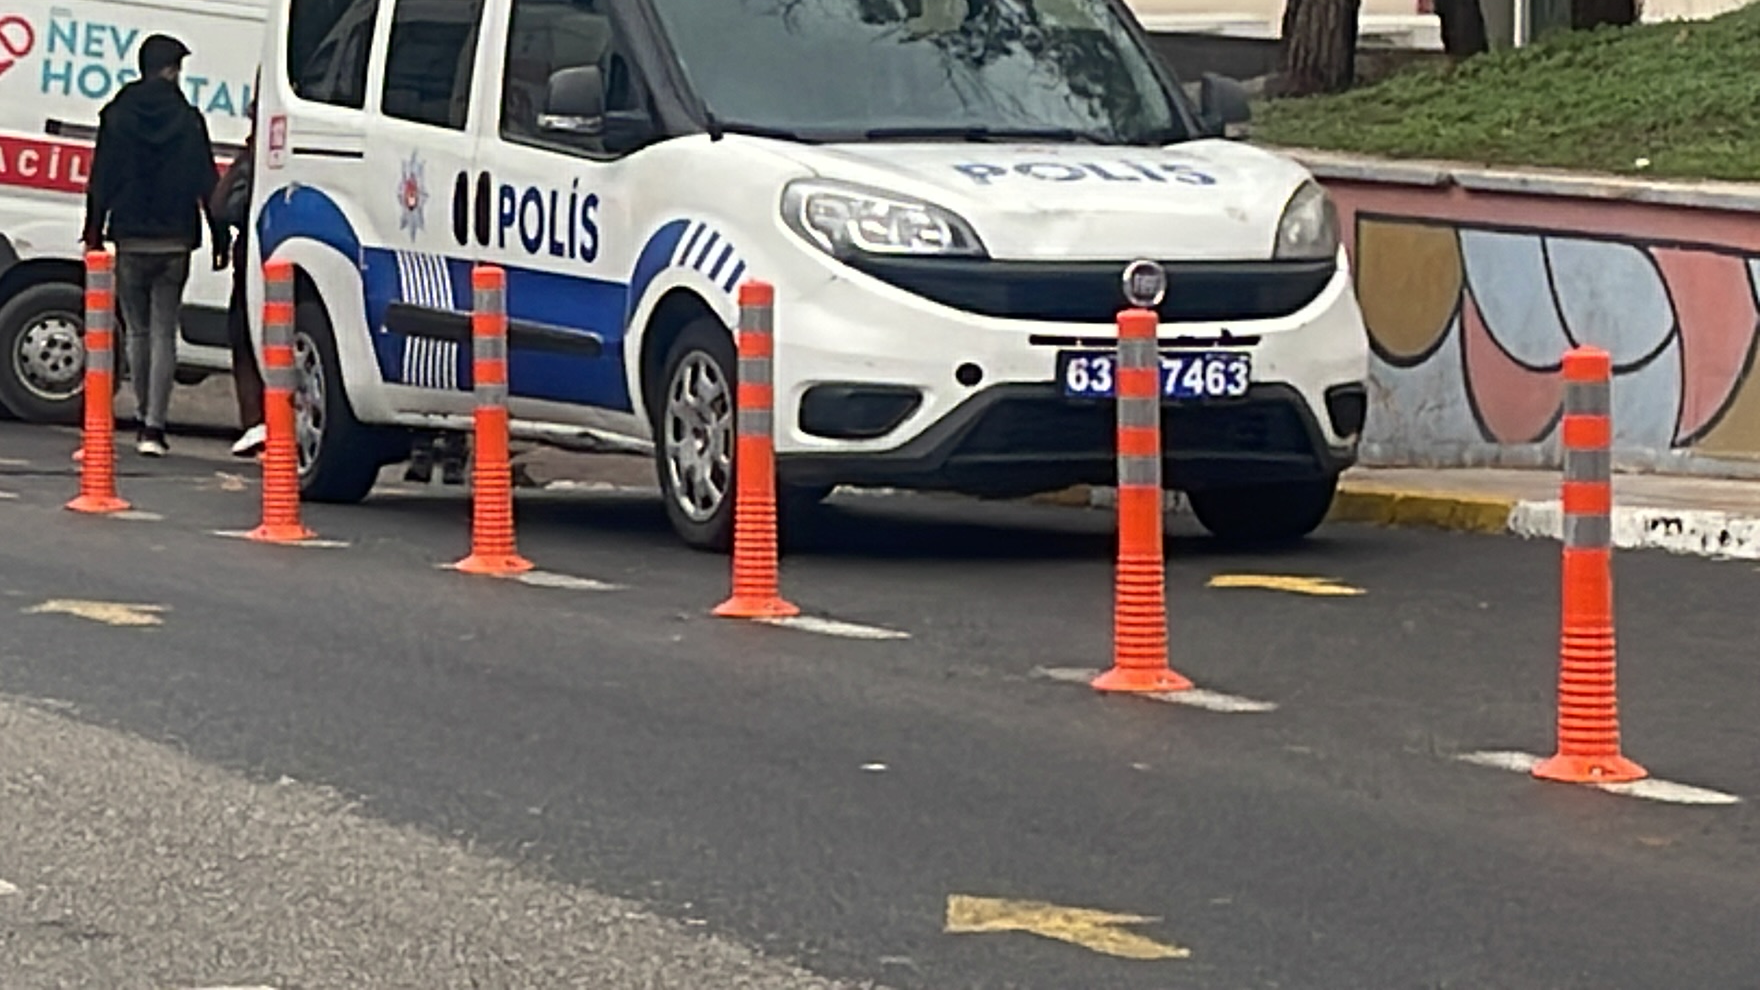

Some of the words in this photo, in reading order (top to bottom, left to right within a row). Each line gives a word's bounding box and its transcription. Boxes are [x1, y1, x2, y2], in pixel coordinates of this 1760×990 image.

[498, 176, 600, 264] POLİS
[1066, 357, 1113, 392] 63
[1160, 357, 1249, 396] 7463
